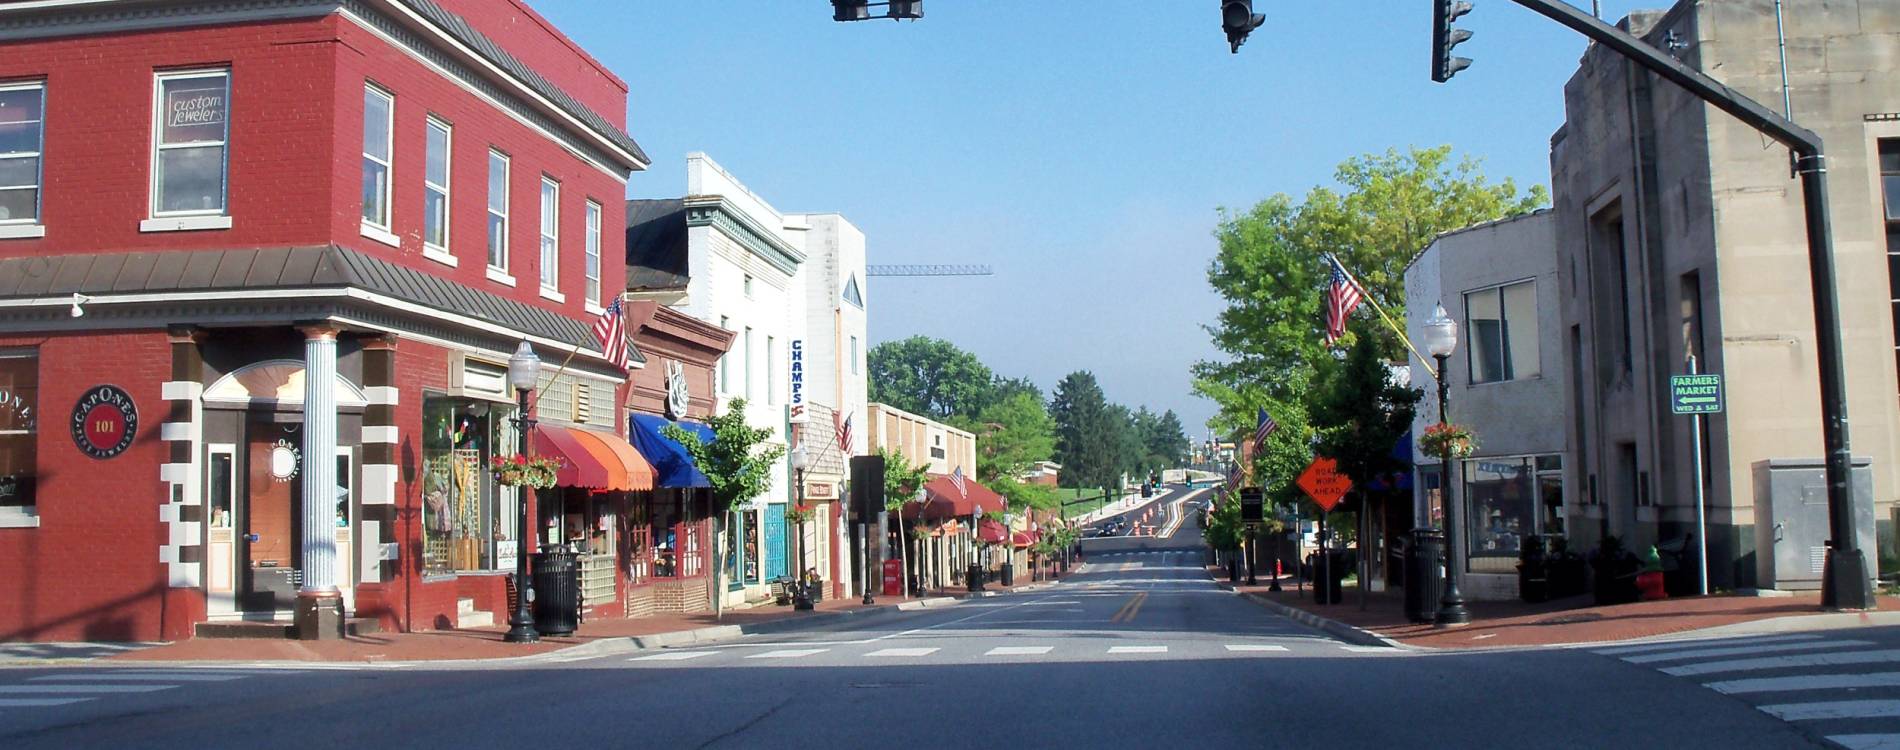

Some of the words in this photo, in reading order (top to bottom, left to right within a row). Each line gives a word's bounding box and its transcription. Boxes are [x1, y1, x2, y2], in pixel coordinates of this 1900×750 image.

[174, 96, 222, 111] custom
[791, 339, 803, 404] CHAMPS
[1673, 376, 1719, 386] FARMERS
[1676, 386, 1717, 395] MARKET
[95, 420, 114, 433] 101
[1315, 467, 1337, 476] ROAD
[1315, 477, 1338, 486] WORK
[1313, 487, 1341, 496] AHEAD
